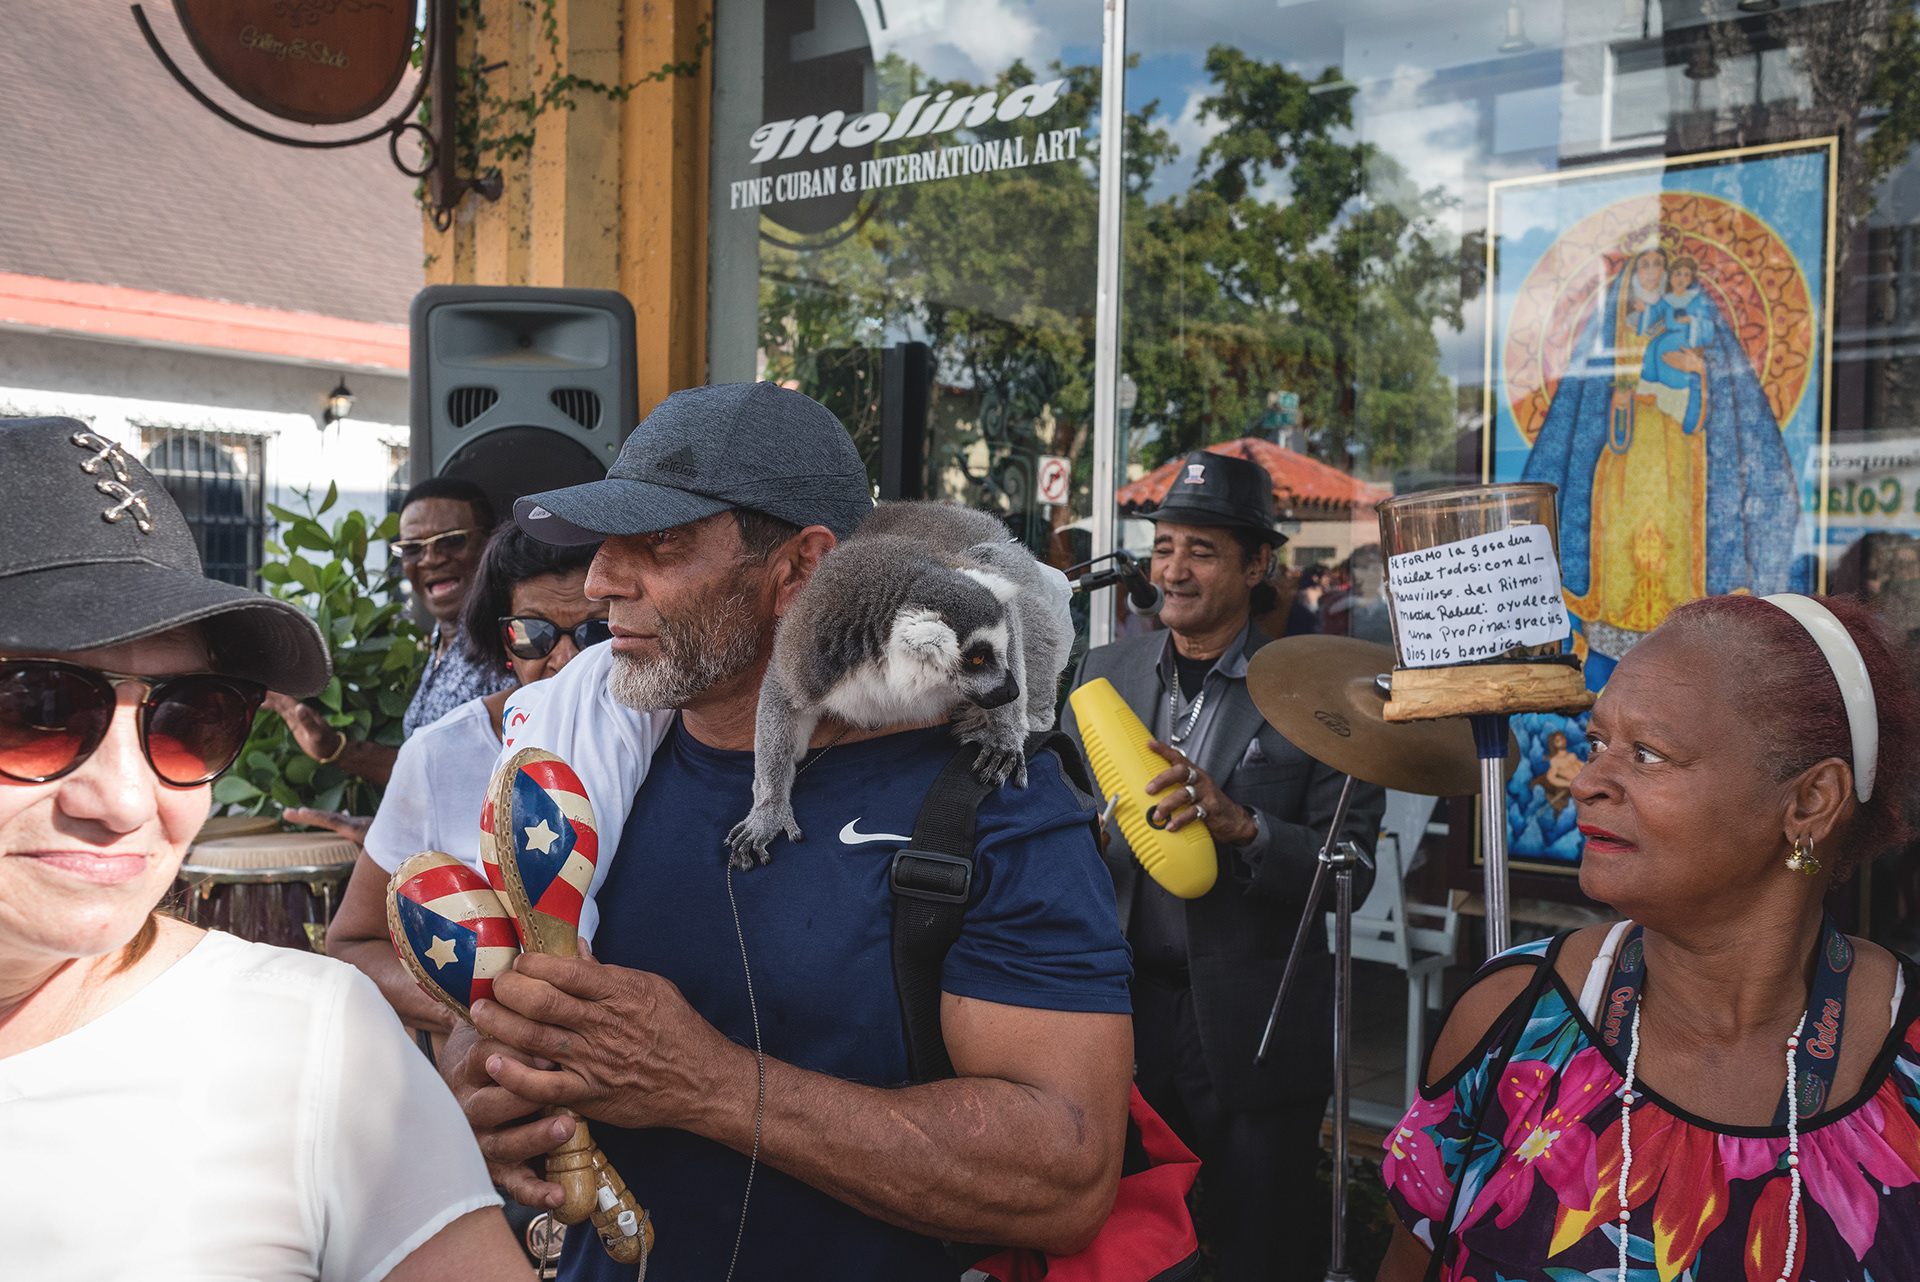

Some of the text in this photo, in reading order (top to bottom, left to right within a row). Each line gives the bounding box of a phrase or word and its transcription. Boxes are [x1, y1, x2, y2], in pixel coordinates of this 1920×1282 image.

[729, 126, 1082, 210] FINE CUBAN & INTERNATIONAL ART
[656, 460, 698, 478] adidas
[1603, 986, 1634, 1047] Gators
[1806, 998, 1842, 1060] Gators
